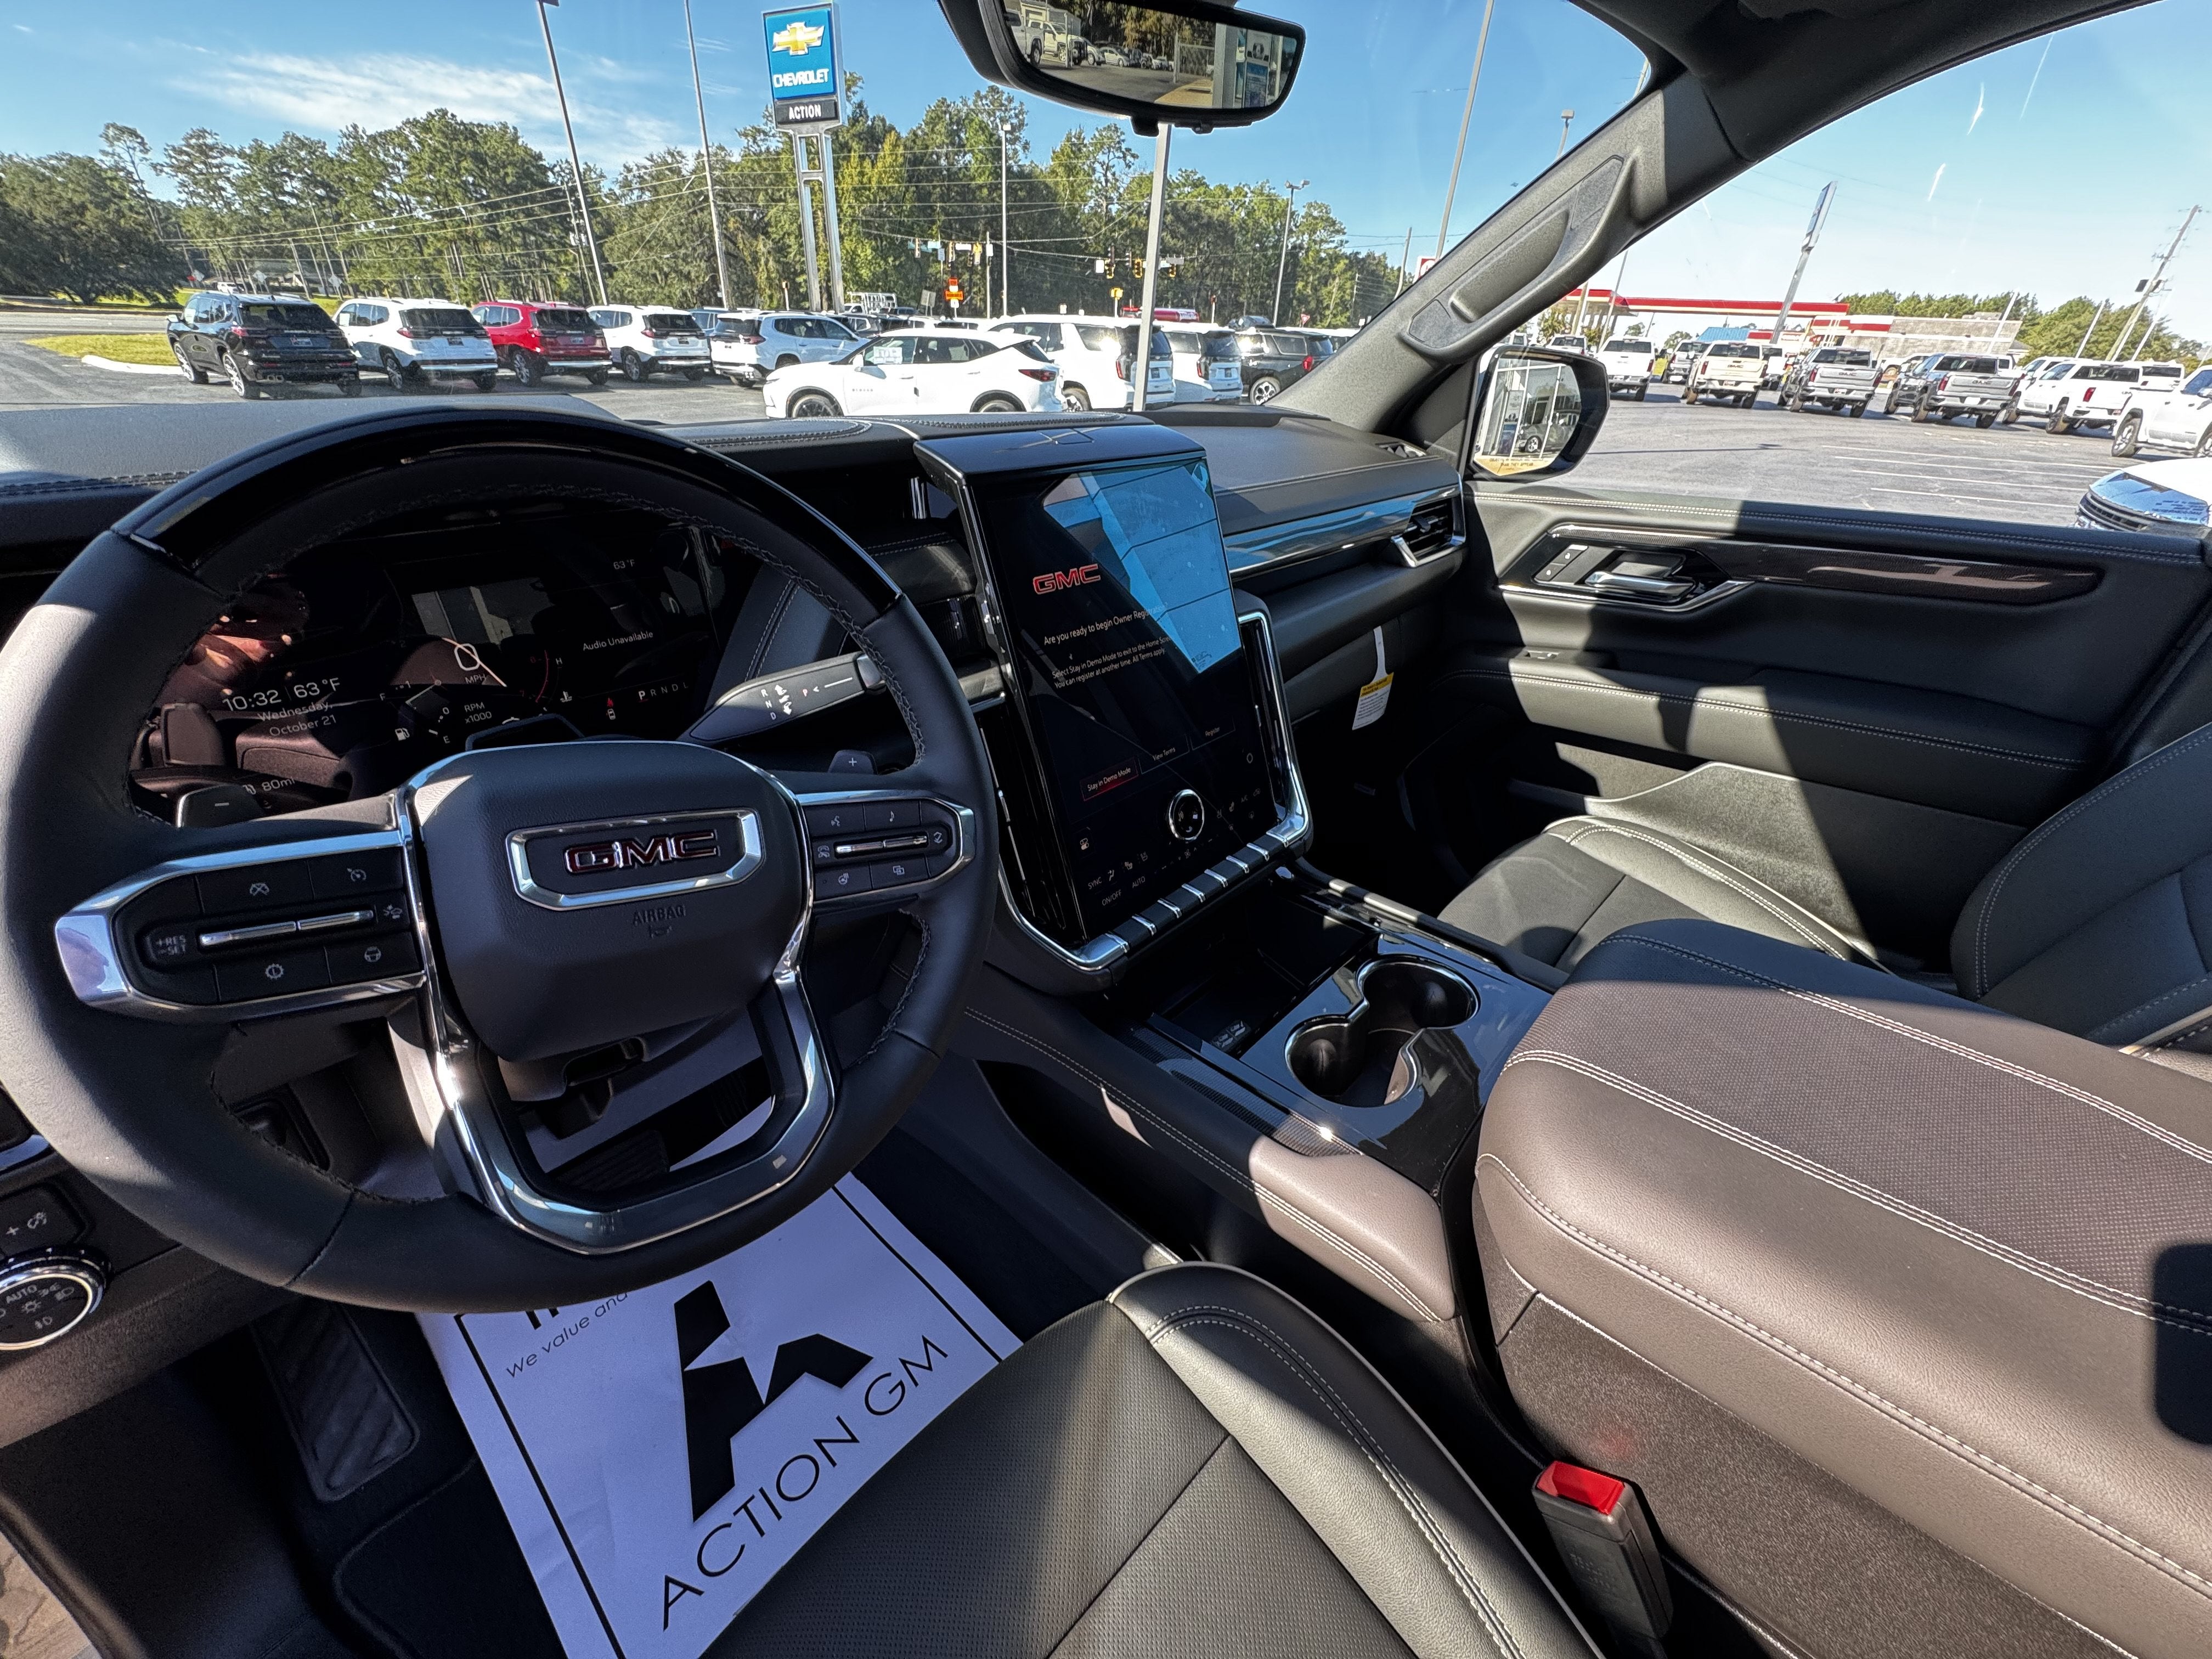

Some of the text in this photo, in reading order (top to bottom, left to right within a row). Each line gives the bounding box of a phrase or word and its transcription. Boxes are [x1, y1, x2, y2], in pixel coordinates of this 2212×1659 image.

[772, 69, 830, 88] CHEVROLET
[789, 104, 822, 120] ACTION
[1032, 564, 1101, 595] GMC
[1044, 636, 1056, 645] Are
[1056, 632, 1069, 644] you
[1070, 625, 1087, 638] ready
[1088, 624, 1095, 633] to
[1096, 618, 1113, 631] begin
[1113, 613, 1133, 625] Owner
[583, 631, 654, 651] Audio Unavailable
[454, 643, 481, 671] 0
[1052, 669, 1069, 679] Select
[1069, 664, 1081, 674] Stay
[1087, 658, 1102, 668] Demo
[1102, 653, 1116, 662] Mode
[1123, 647, 1132, 656] exit
[1146, 639, 1159, 647] Home
[465, 674, 487, 685] MPH
[1054, 680, 1065, 689] You
[1076, 672, 1094, 682] register
[1102, 663, 1120, 674] another
[1139, 653, 1153, 661] Terms
[222, 690, 282, 711] 10:32
[639, 691, 645, 701] P
[761, 689, 768, 698] R
[464, 702, 486, 713] RPM
[465, 711, 492, 724] x1000
[269, 714, 337, 736] October 21
[1204, 726, 1220, 737] Register
[443, 736, 450, 744] E
[1152, 747, 1176, 761] View Terms
[1087, 781, 1098, 792] Stay
[1103, 772, 1118, 784] Demo
[1118, 768, 1131, 778] Mode
[564, 831, 718, 874] GMC
[1088, 877, 1102, 889] SYNC
[1132, 876, 1146, 888] AUTO
[1102, 889, 1122, 906] ON/OFF
[633, 904, 686, 926] AIRBAG
[6, 1284, 37, 1304] AUTO
[506, 1354, 537, 1378] We
[541, 1317, 590, 1353] value
[663, 1335, 949, 1632] ACTION GM
